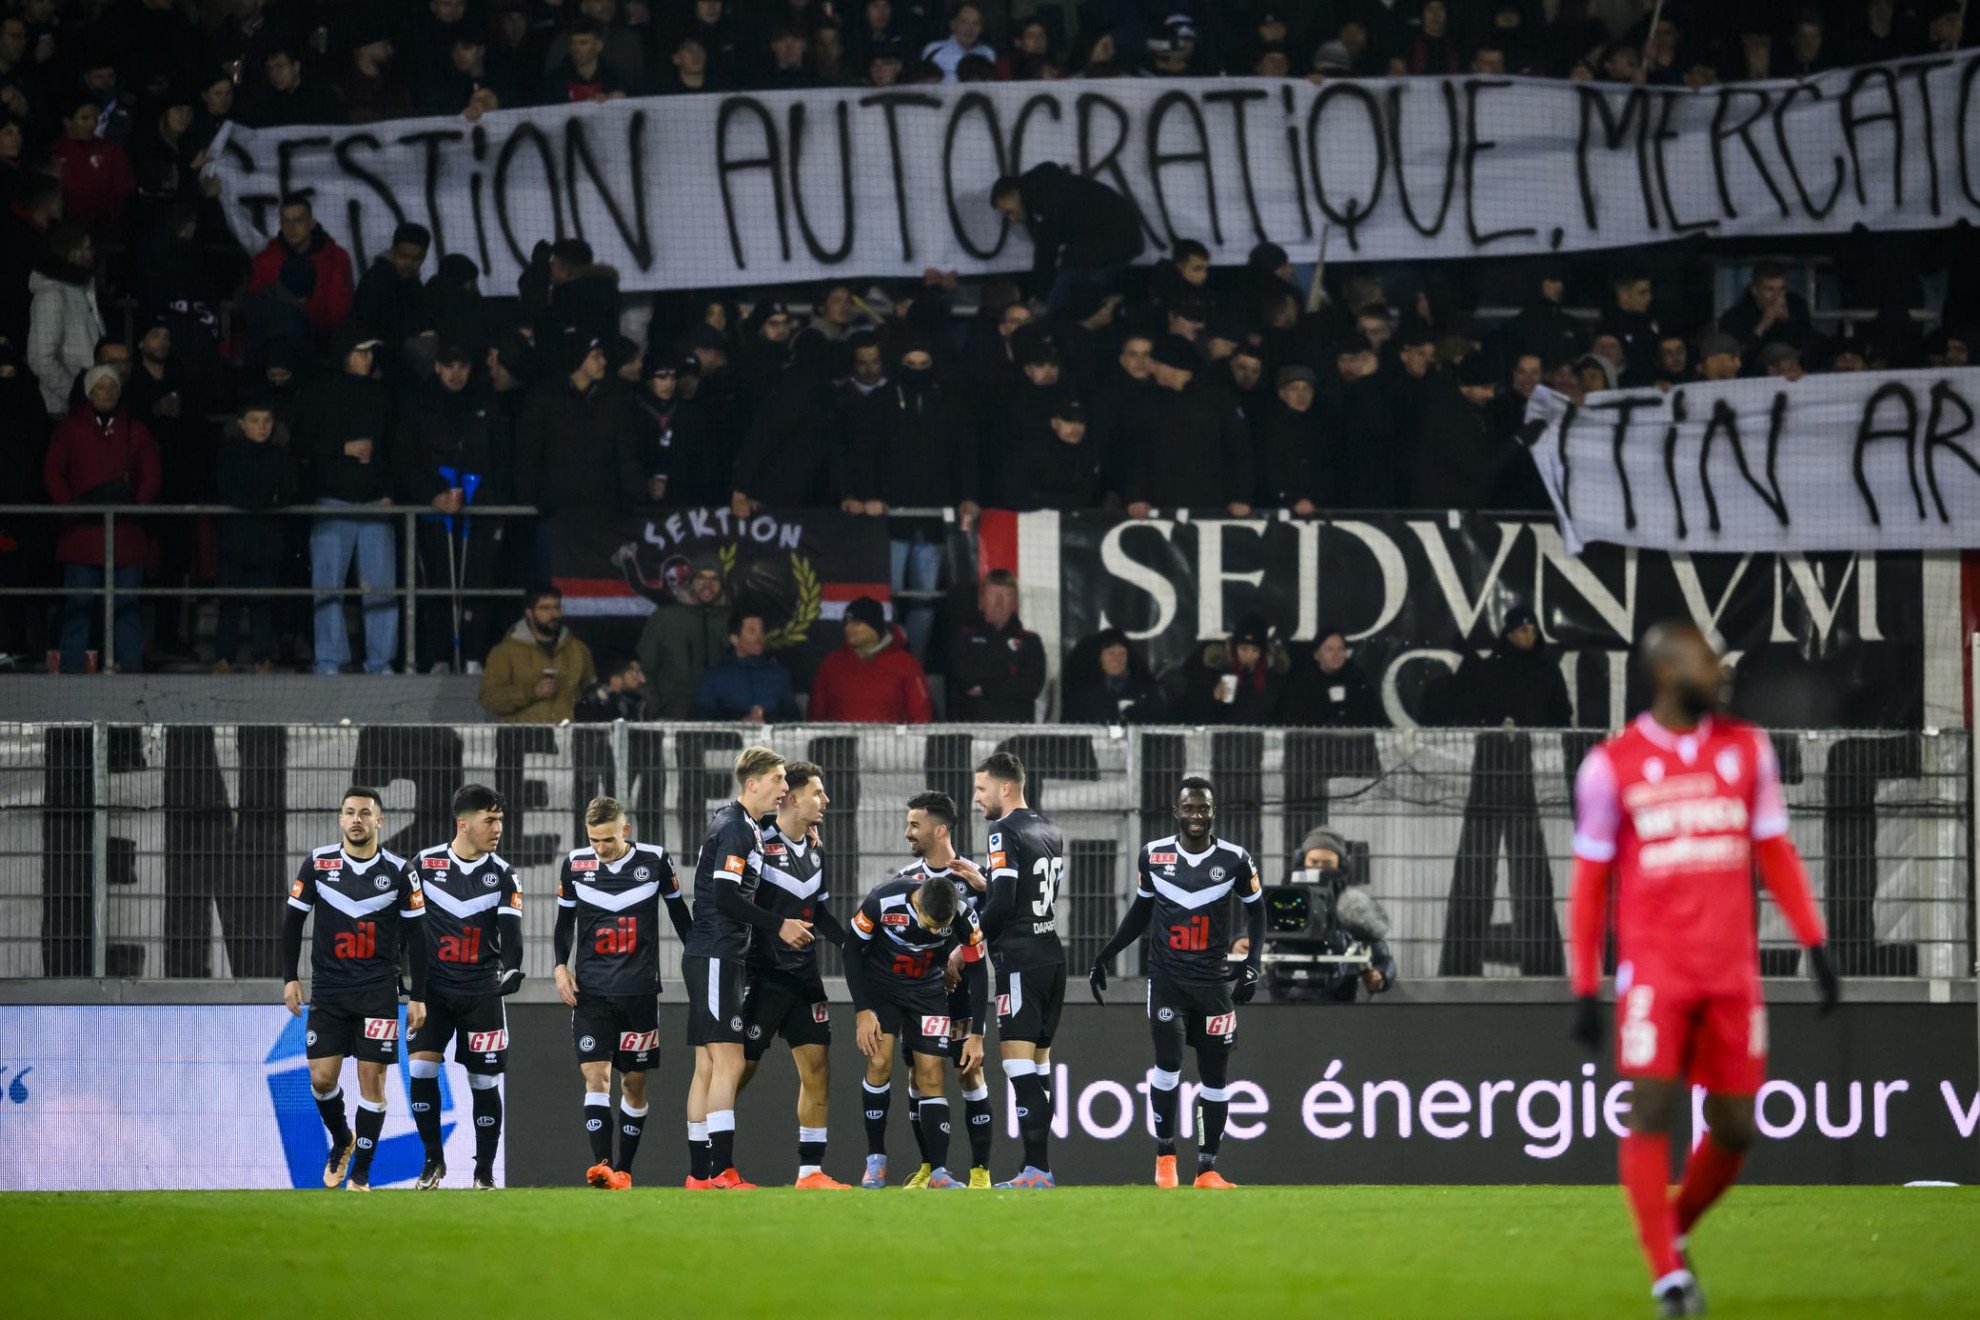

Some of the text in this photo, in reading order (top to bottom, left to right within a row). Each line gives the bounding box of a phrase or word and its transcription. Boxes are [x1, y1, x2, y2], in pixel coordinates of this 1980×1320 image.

[644, 507, 802, 550] SEKTION
[335, 921, 376, 960] ail
[437, 926, 482, 964] ail
[595, 916, 638, 955] ail
[1168, 916, 1209, 951] ail
[470, 1030, 505, 1051] GTL
[621, 1030, 657, 1050] GTL
[1007, 1063, 1269, 1139] Notre
[1302, 1061, 1633, 1160] énergie
